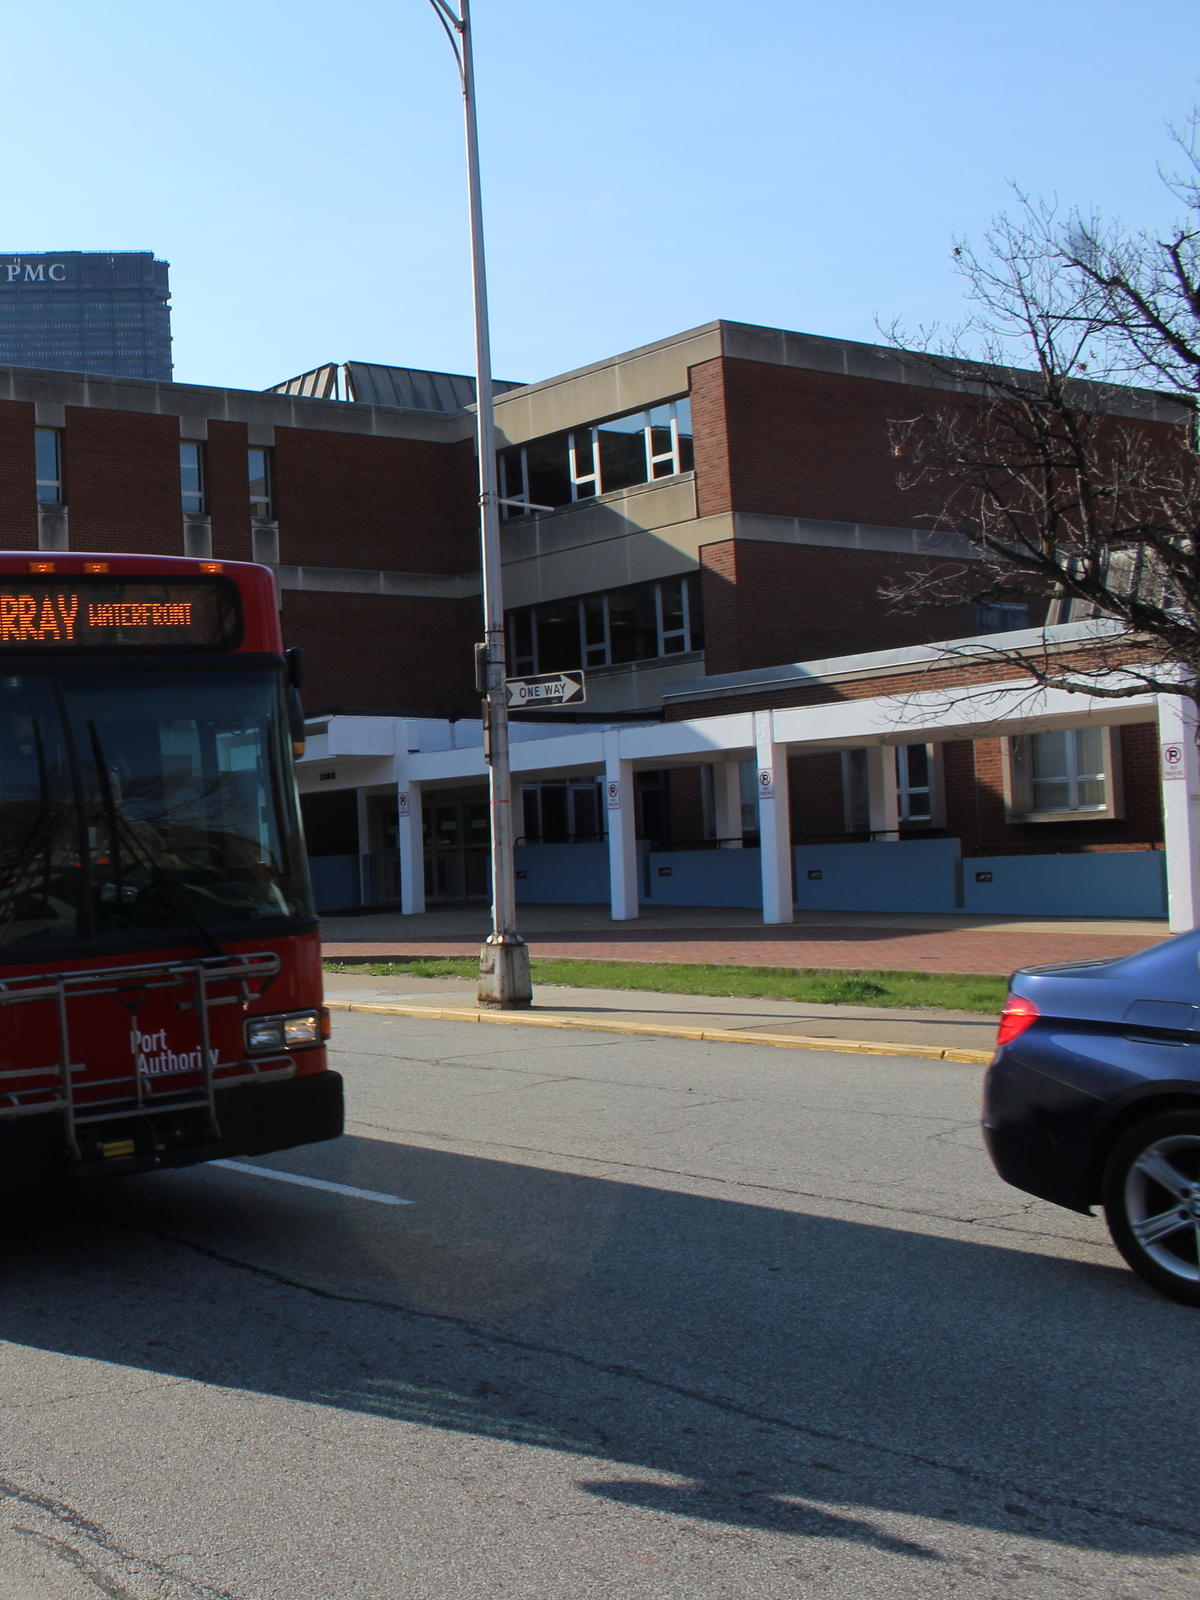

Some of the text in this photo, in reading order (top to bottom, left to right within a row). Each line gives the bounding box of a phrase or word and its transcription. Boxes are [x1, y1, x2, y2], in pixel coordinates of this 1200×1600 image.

[88, 603, 192, 626] WATERFRONT
[519, 683, 566, 698] ONE WAY
[130, 1029, 167, 1054] Port
[139, 1045, 219, 1074] Authoriy
